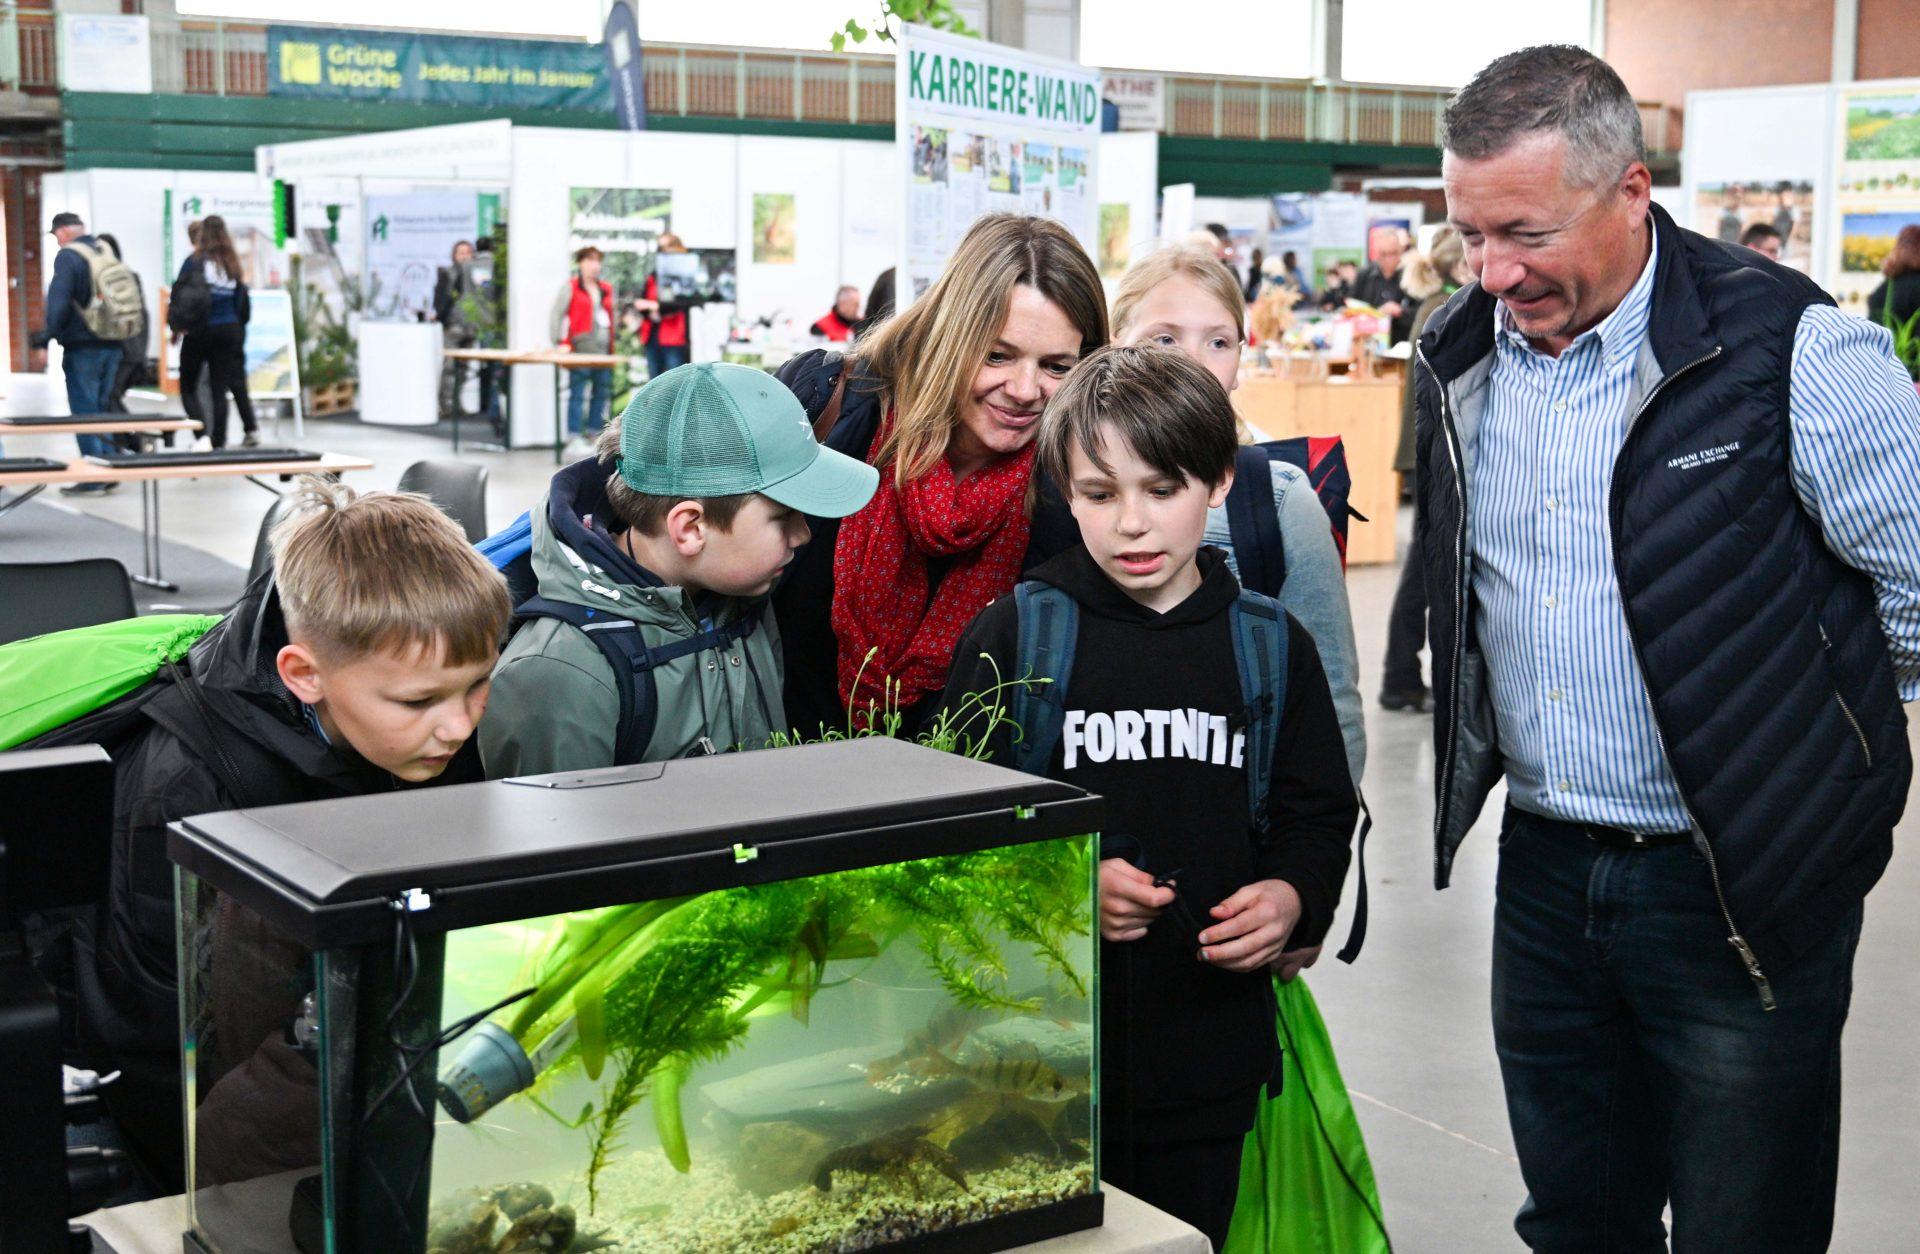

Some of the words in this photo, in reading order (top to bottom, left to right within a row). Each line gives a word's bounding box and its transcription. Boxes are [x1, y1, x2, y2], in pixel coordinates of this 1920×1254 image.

[327, 43, 397, 67] Grüne
[327, 66, 401, 89] Woche
[418, 62, 470, 82] Jedes
[909, 50, 1097, 125] KARRIERE-WAND
[1667, 453, 1698, 468] ARMANI
[1699, 441, 1740, 459] EXCHANGE
